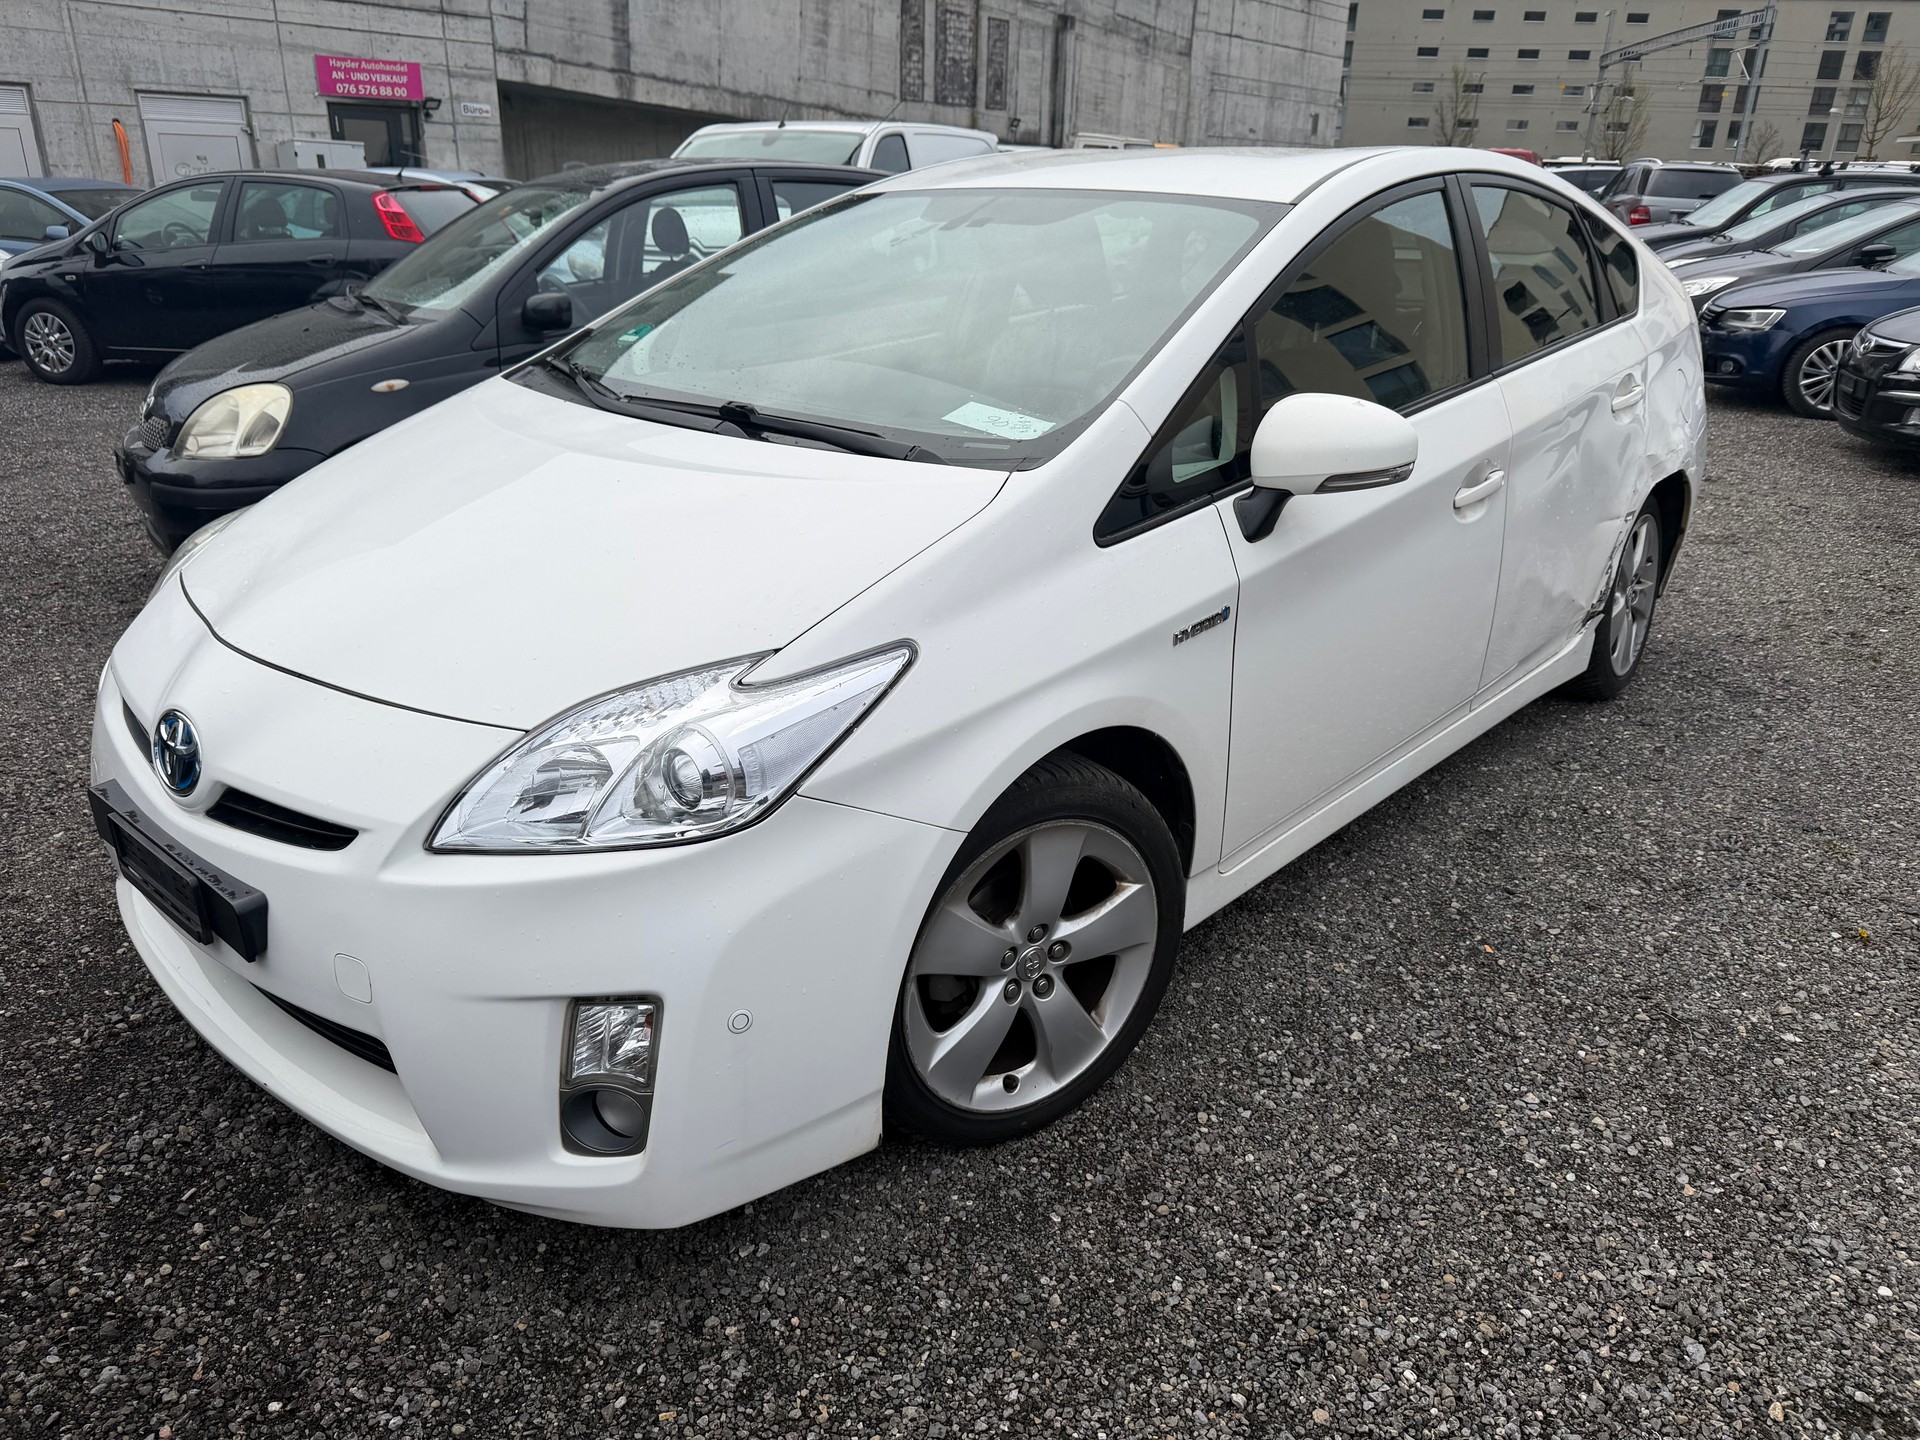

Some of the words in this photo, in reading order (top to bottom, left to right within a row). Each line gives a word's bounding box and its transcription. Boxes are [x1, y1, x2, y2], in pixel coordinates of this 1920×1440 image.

[329, 58, 359, 70] Hayder
[361, 61, 408, 72] Autohandel
[332, 71, 344, 80] AN
[351, 72, 370, 82] UND
[371, 74, 408, 84] VERKAUF
[336, 83, 356, 94] 076
[358, 84, 378, 95] 576
[380, 86, 393, 96] 88
[394, 87, 407, 97] 00
[463, 104, 484, 115] Büro
[1173, 609, 1227, 647] HYBRID
